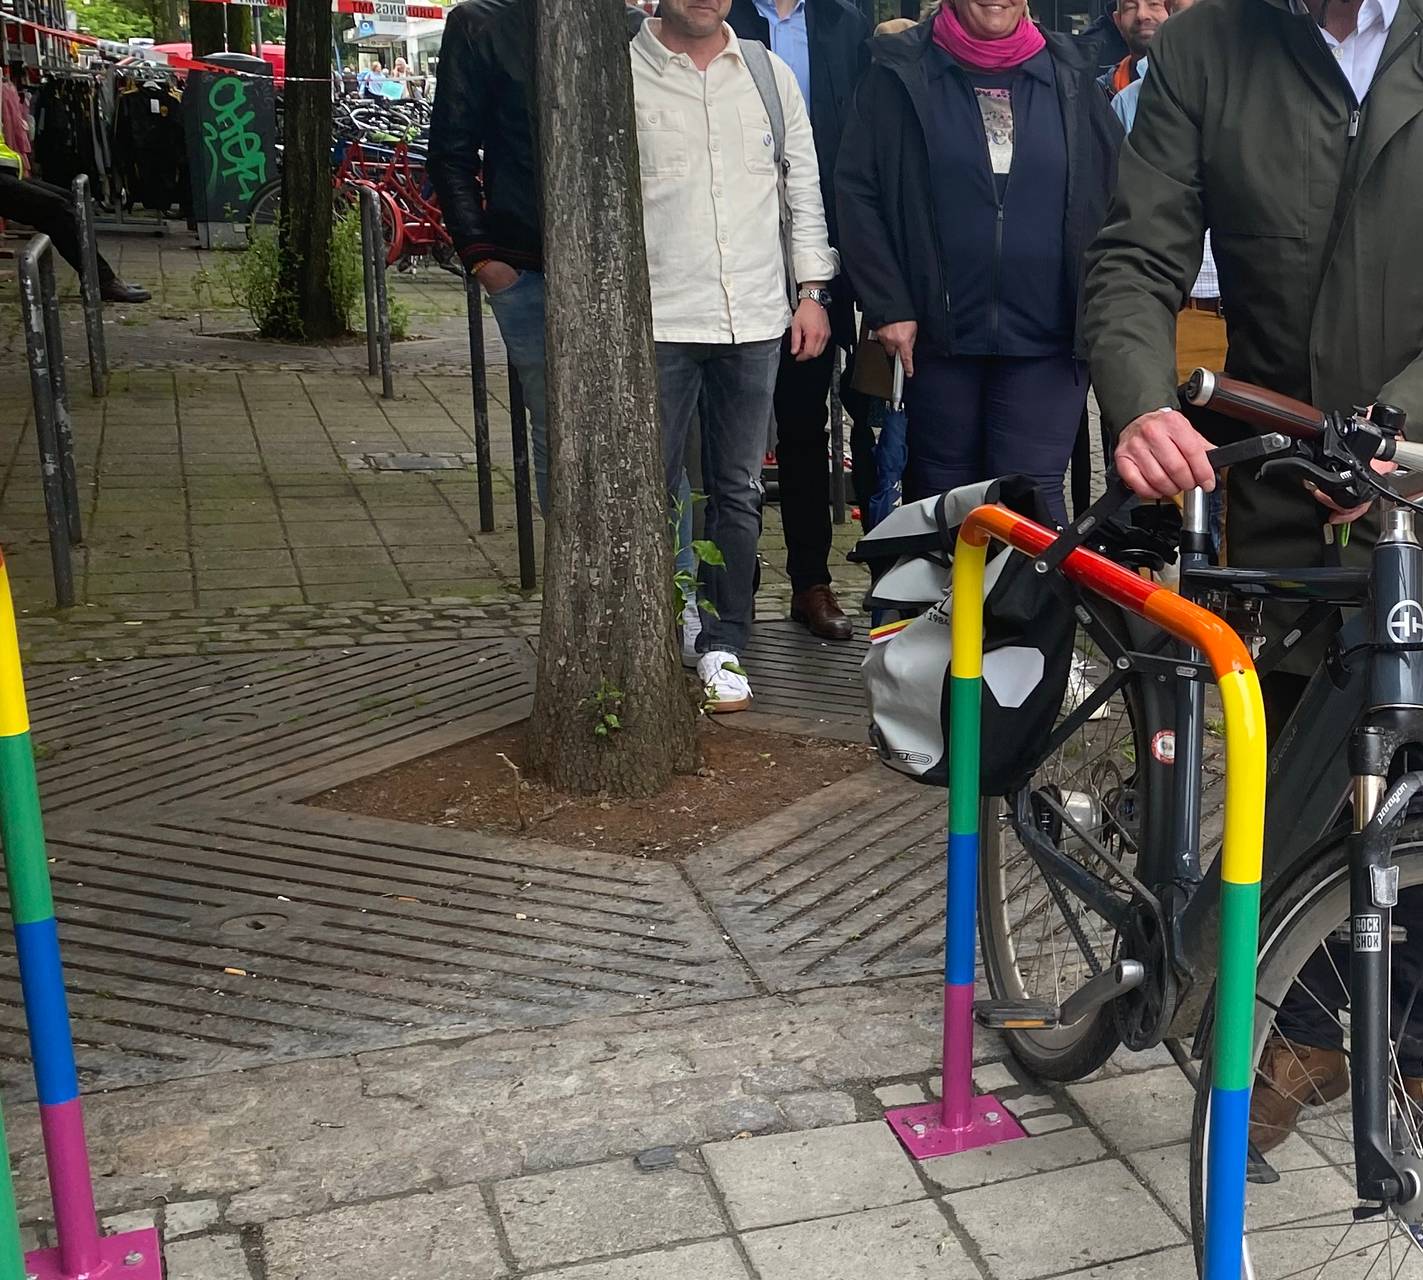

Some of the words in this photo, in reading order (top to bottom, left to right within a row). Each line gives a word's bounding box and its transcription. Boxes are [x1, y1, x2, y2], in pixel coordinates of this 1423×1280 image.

[1376, 782, 1408, 825] paragon
[1355, 918, 1379, 933] ROCK
[1355, 935, 1379, 949] SHOX
